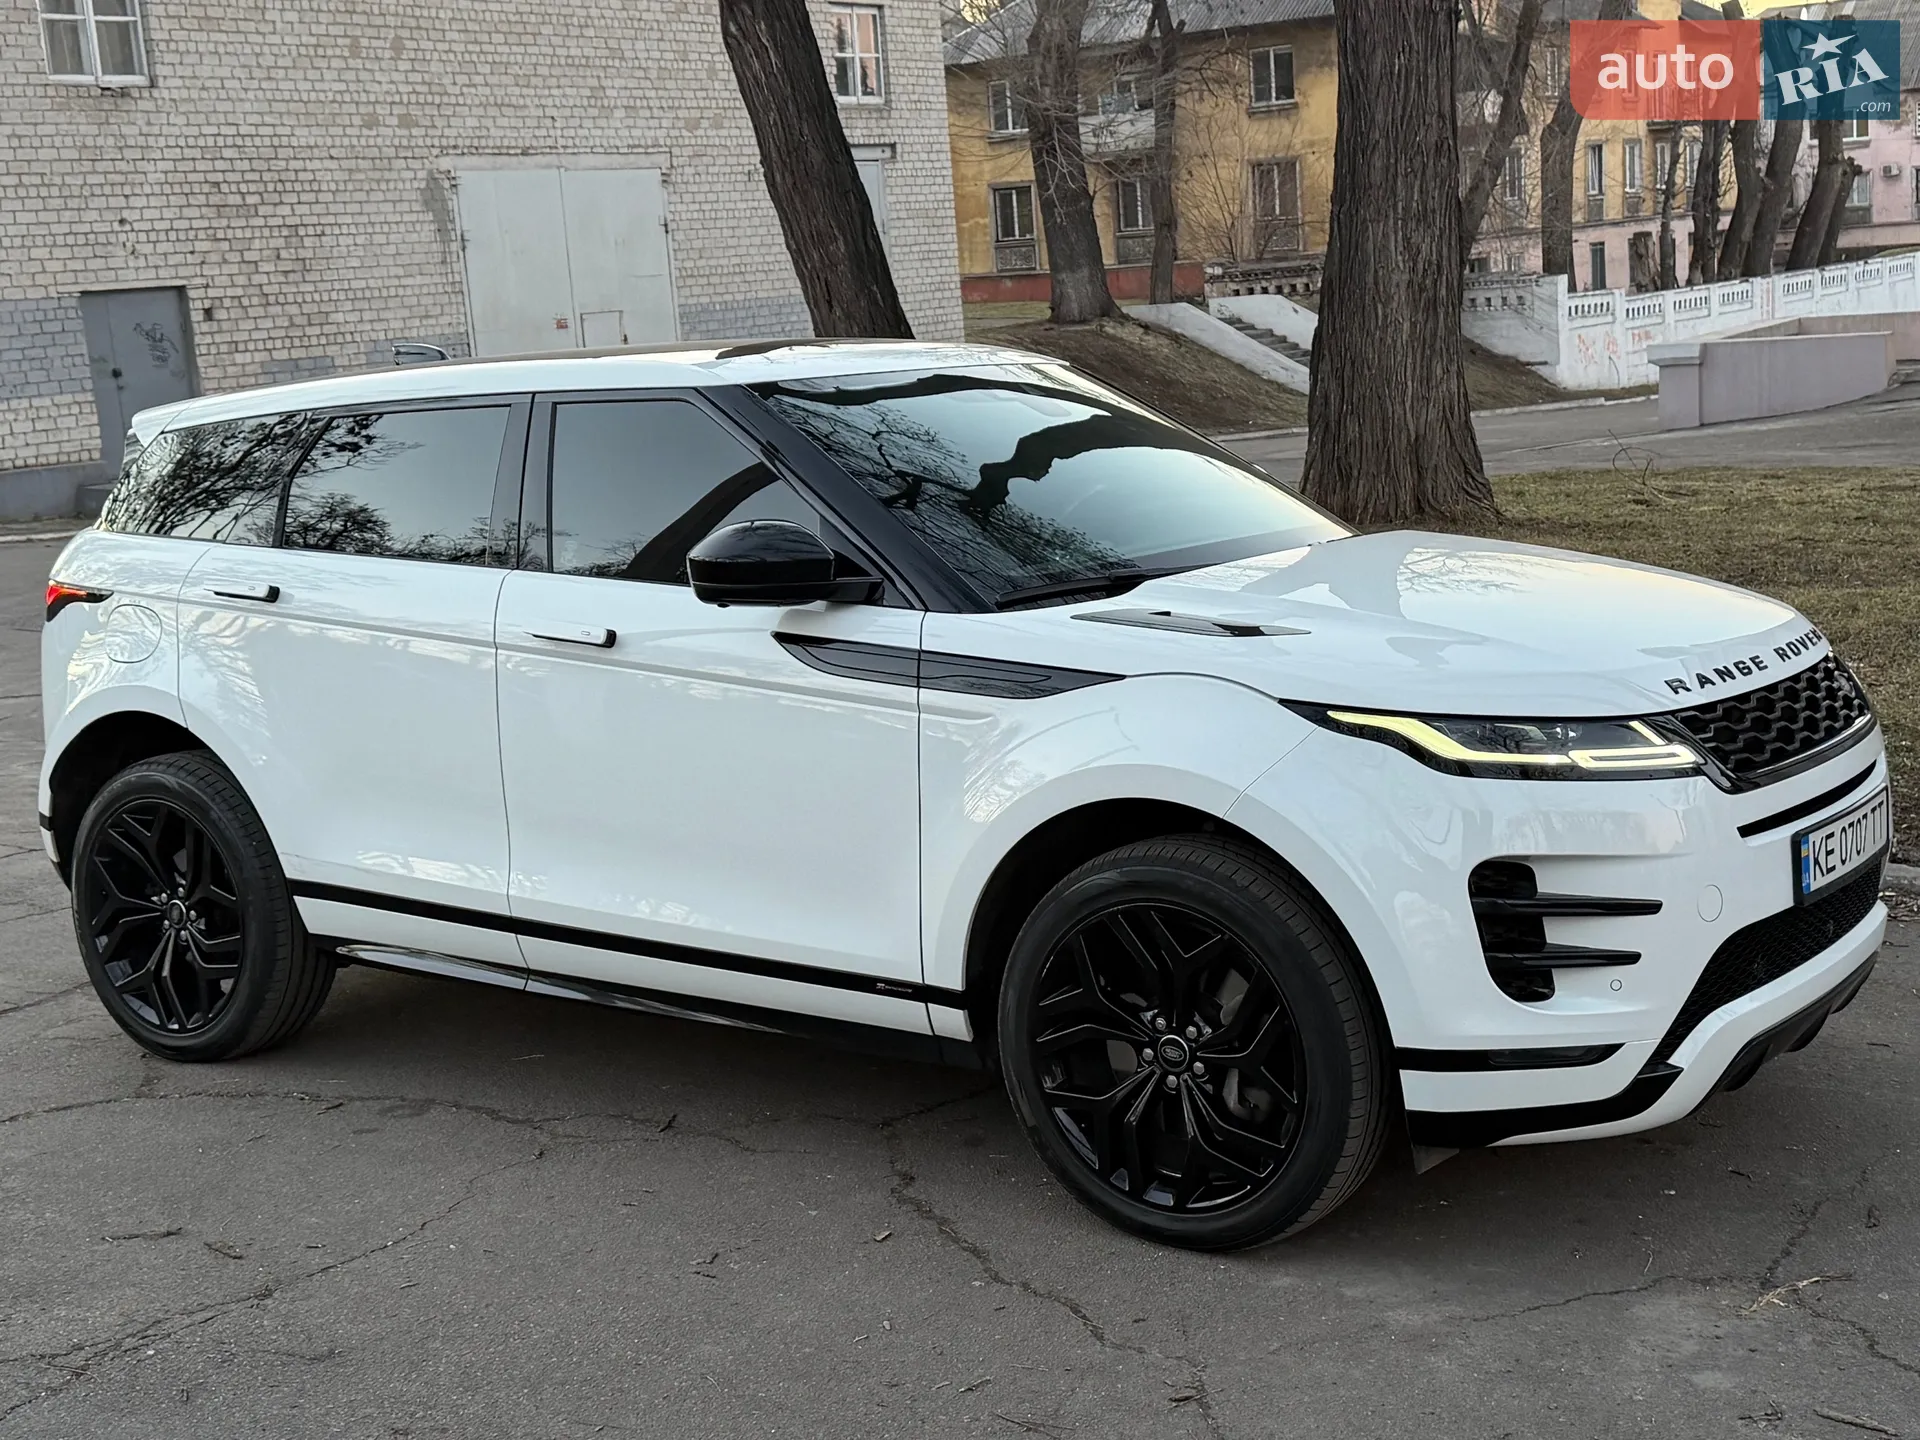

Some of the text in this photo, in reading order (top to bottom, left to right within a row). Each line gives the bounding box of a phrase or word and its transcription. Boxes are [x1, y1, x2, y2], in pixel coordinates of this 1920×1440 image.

[1663, 626, 1823, 695] RANGE ROVER
[1812, 800, 1884, 882] KE 0707 TT
